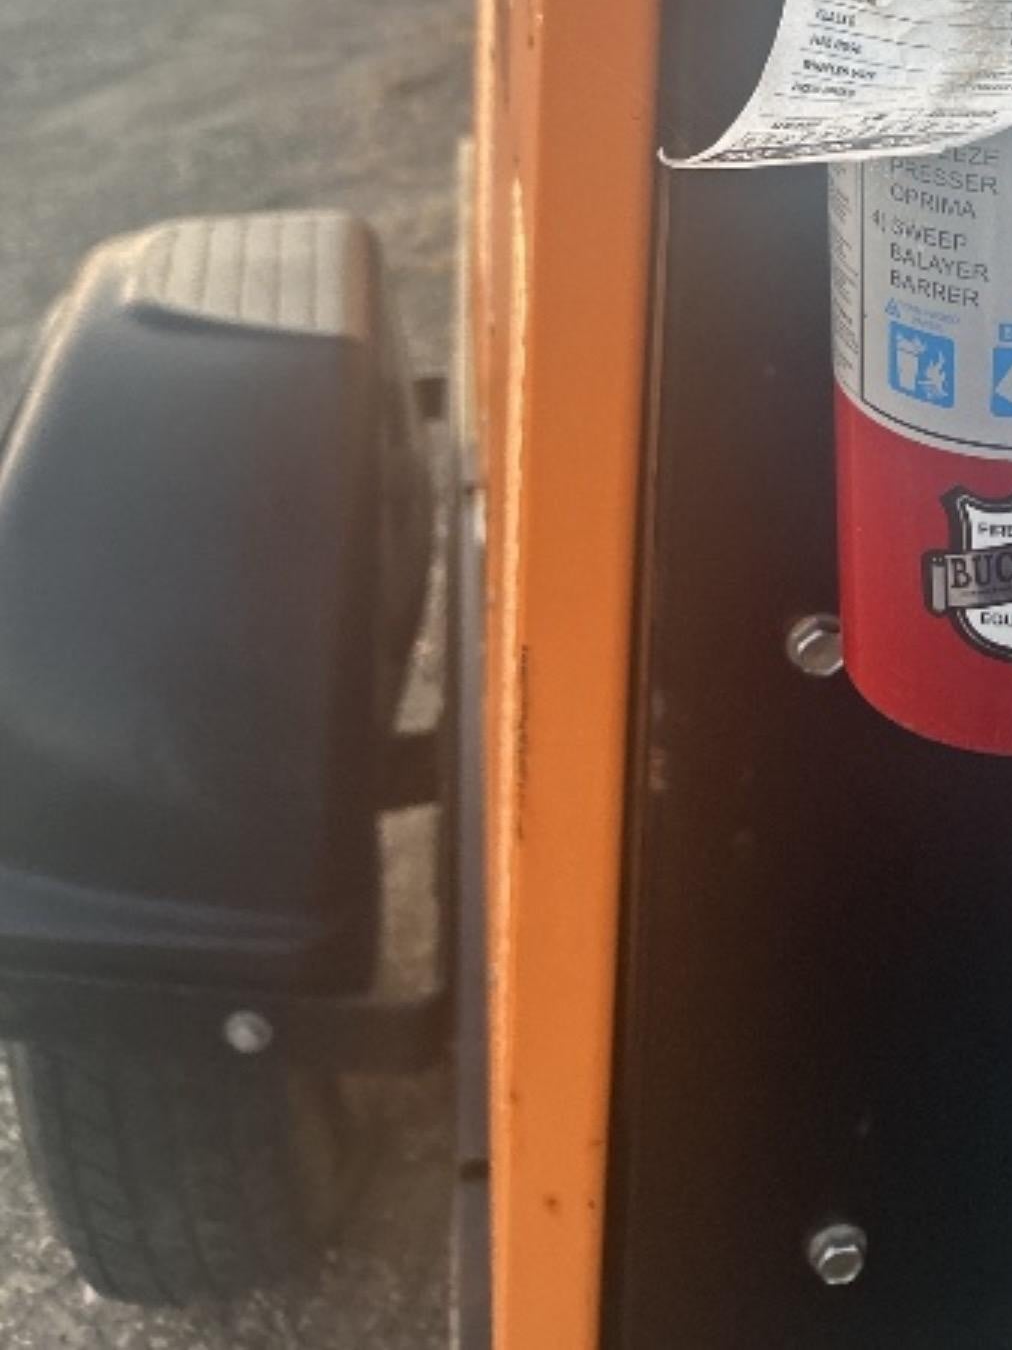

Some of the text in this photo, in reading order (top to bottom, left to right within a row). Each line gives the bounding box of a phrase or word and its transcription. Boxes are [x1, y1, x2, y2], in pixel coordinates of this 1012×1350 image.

[889, 157, 999, 195] PRESSER
[890, 217, 968, 251] SWEEP
[889, 242, 990, 283] BALAYER
[889, 269, 980, 308] BARRER
